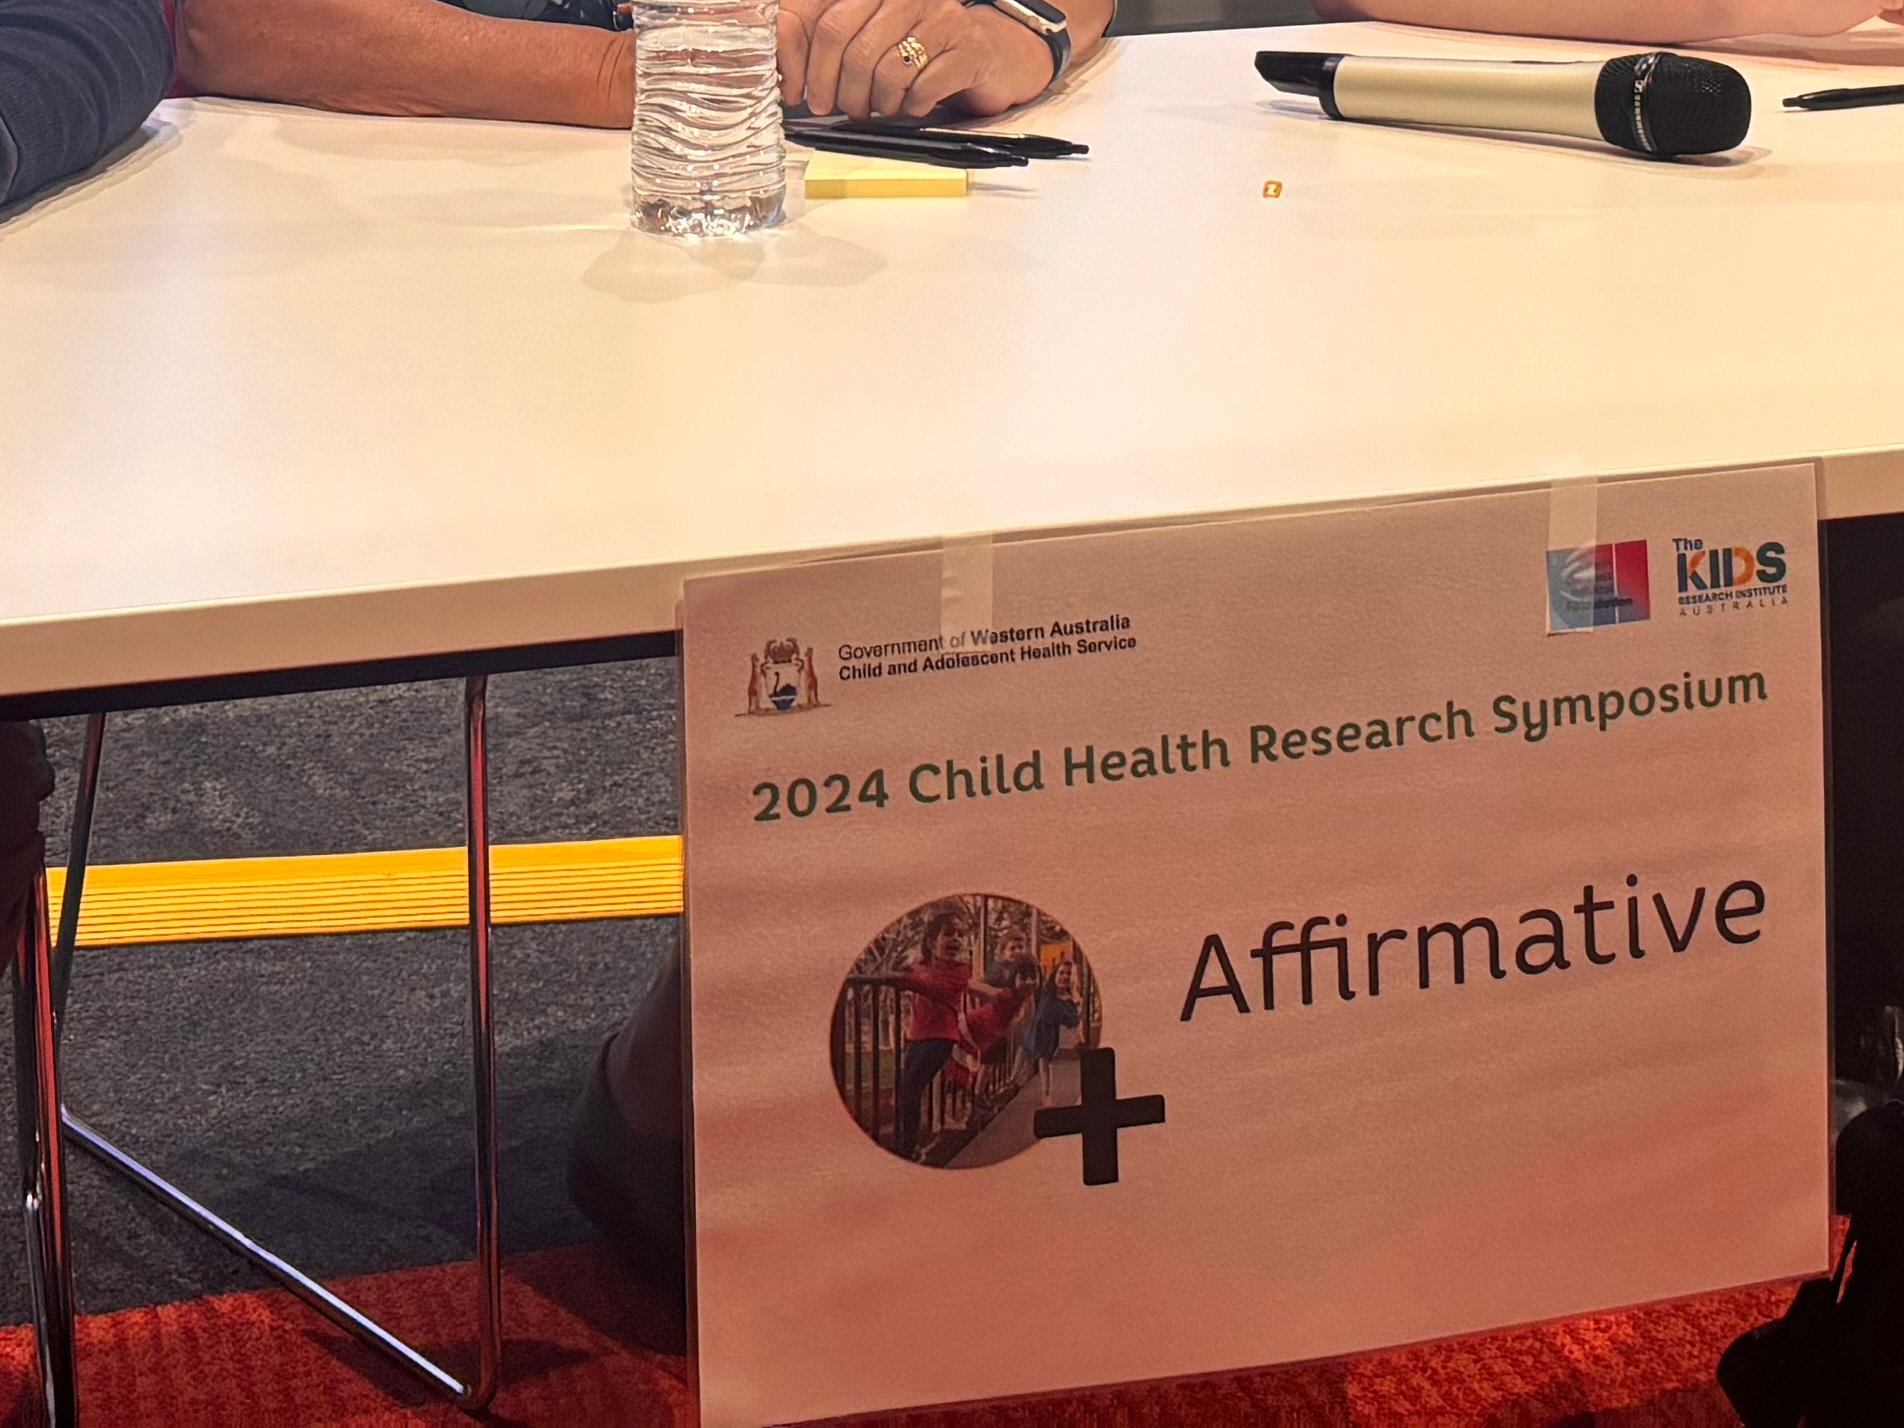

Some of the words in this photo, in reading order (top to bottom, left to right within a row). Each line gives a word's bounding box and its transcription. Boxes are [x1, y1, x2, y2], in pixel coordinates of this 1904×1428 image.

[1672, 538, 1703, 552] The
[1677, 542, 1787, 593] KIDS
[1678, 591, 1733, 606] RESEARCH
[839, 633, 944, 660] Government
[950, 630, 967, 648] of
[971, 626, 1045, 646] Western
[1050, 614, 1131, 637] Australia
[839, 662, 882, 680] Child
[888, 659, 918, 676] and
[922, 651, 1015, 672] Adolescent
[1020, 642, 1072, 661] Health
[1077, 635, 1137, 654] Service
[752, 769, 889, 824] 2024
[909, 753, 1044, 805] Child
[1063, 730, 1231, 787] Health
[1248, 699, 1475, 766] Research
[1492, 666, 1768, 744] Symposium
[1178, 873, 1766, 1023] Affirmative
